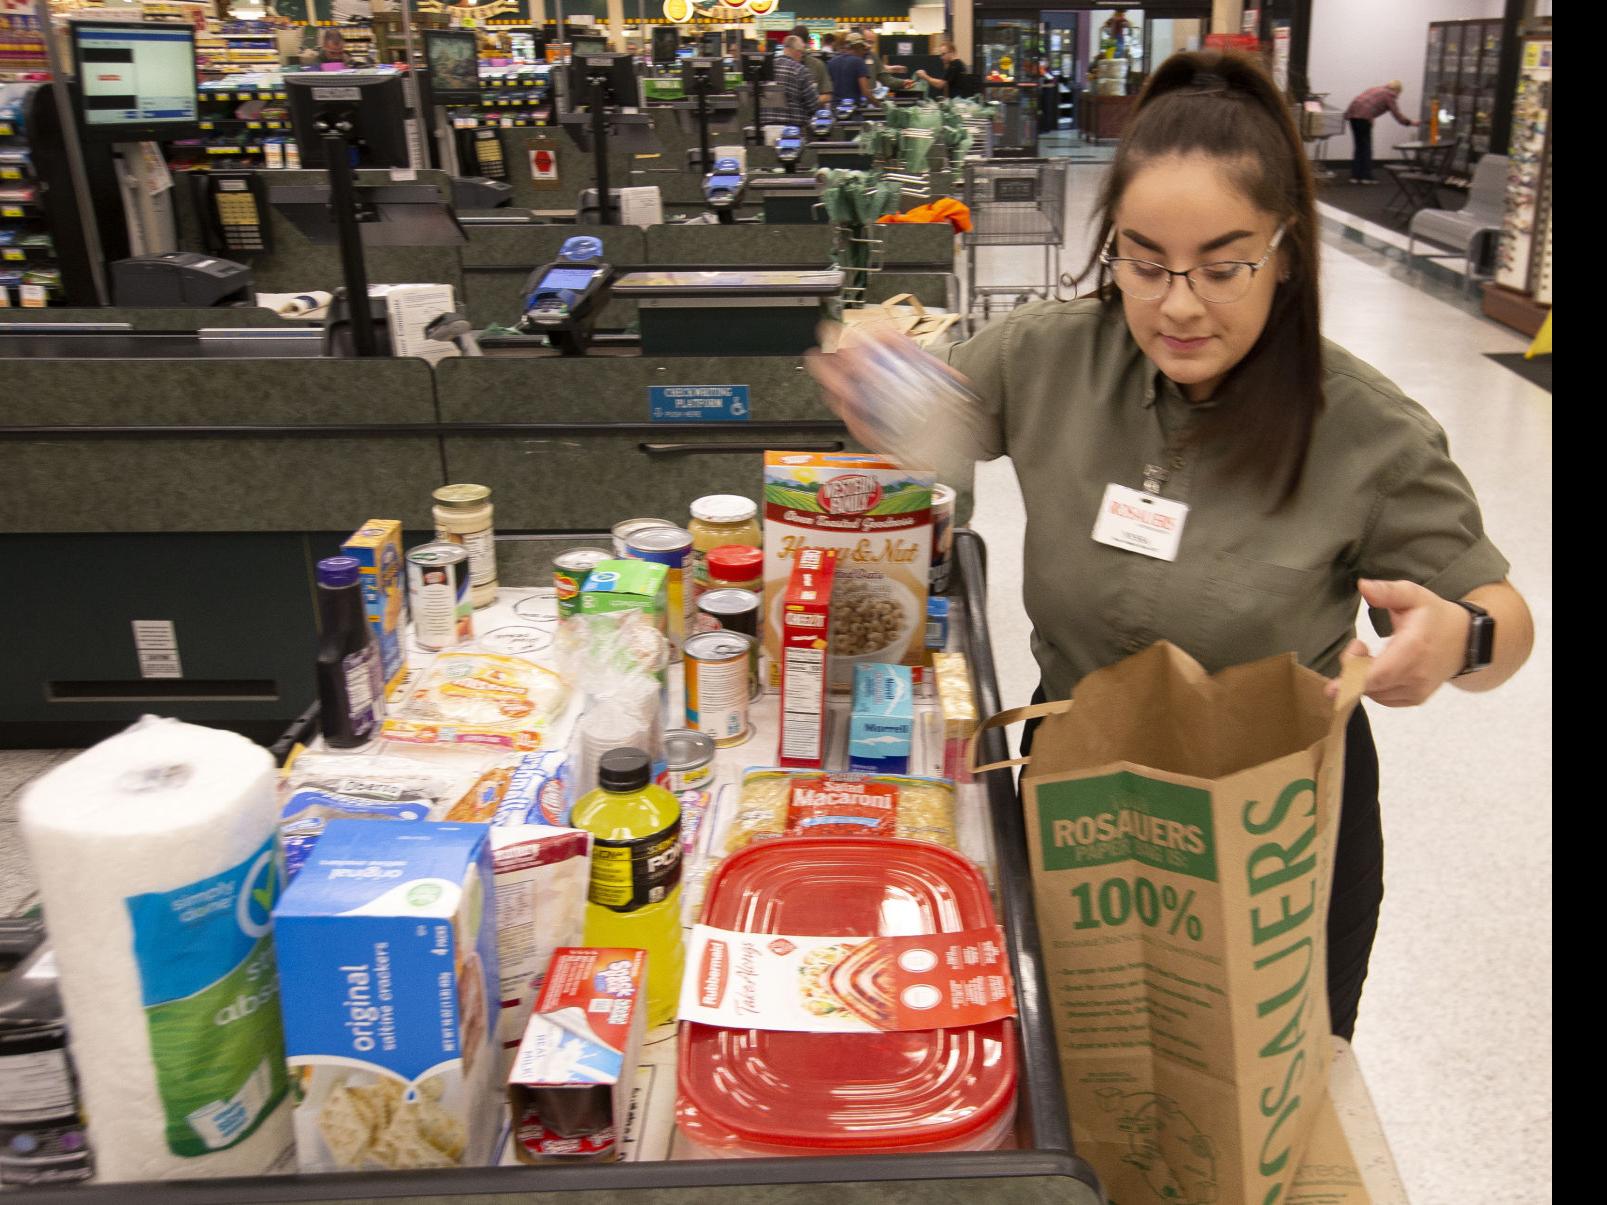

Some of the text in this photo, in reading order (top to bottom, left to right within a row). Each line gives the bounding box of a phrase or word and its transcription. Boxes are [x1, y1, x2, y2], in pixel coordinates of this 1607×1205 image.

[880, 537, 919, 563] Nut
[864, 722, 909, 734] Morrell
[791, 788, 893, 810] Macaroni
[823, 781, 865, 794] Salad
[1052, 808, 1207, 856] ROSAUERS
[1070, 876, 1205, 942] 100%
[373, 941, 396, 1052] saltine crackers
[700, 942, 725, 1005] Rubbermaid
[1242, 777, 1319, 1205] OSAUERS
[338, 963, 380, 1052] original
